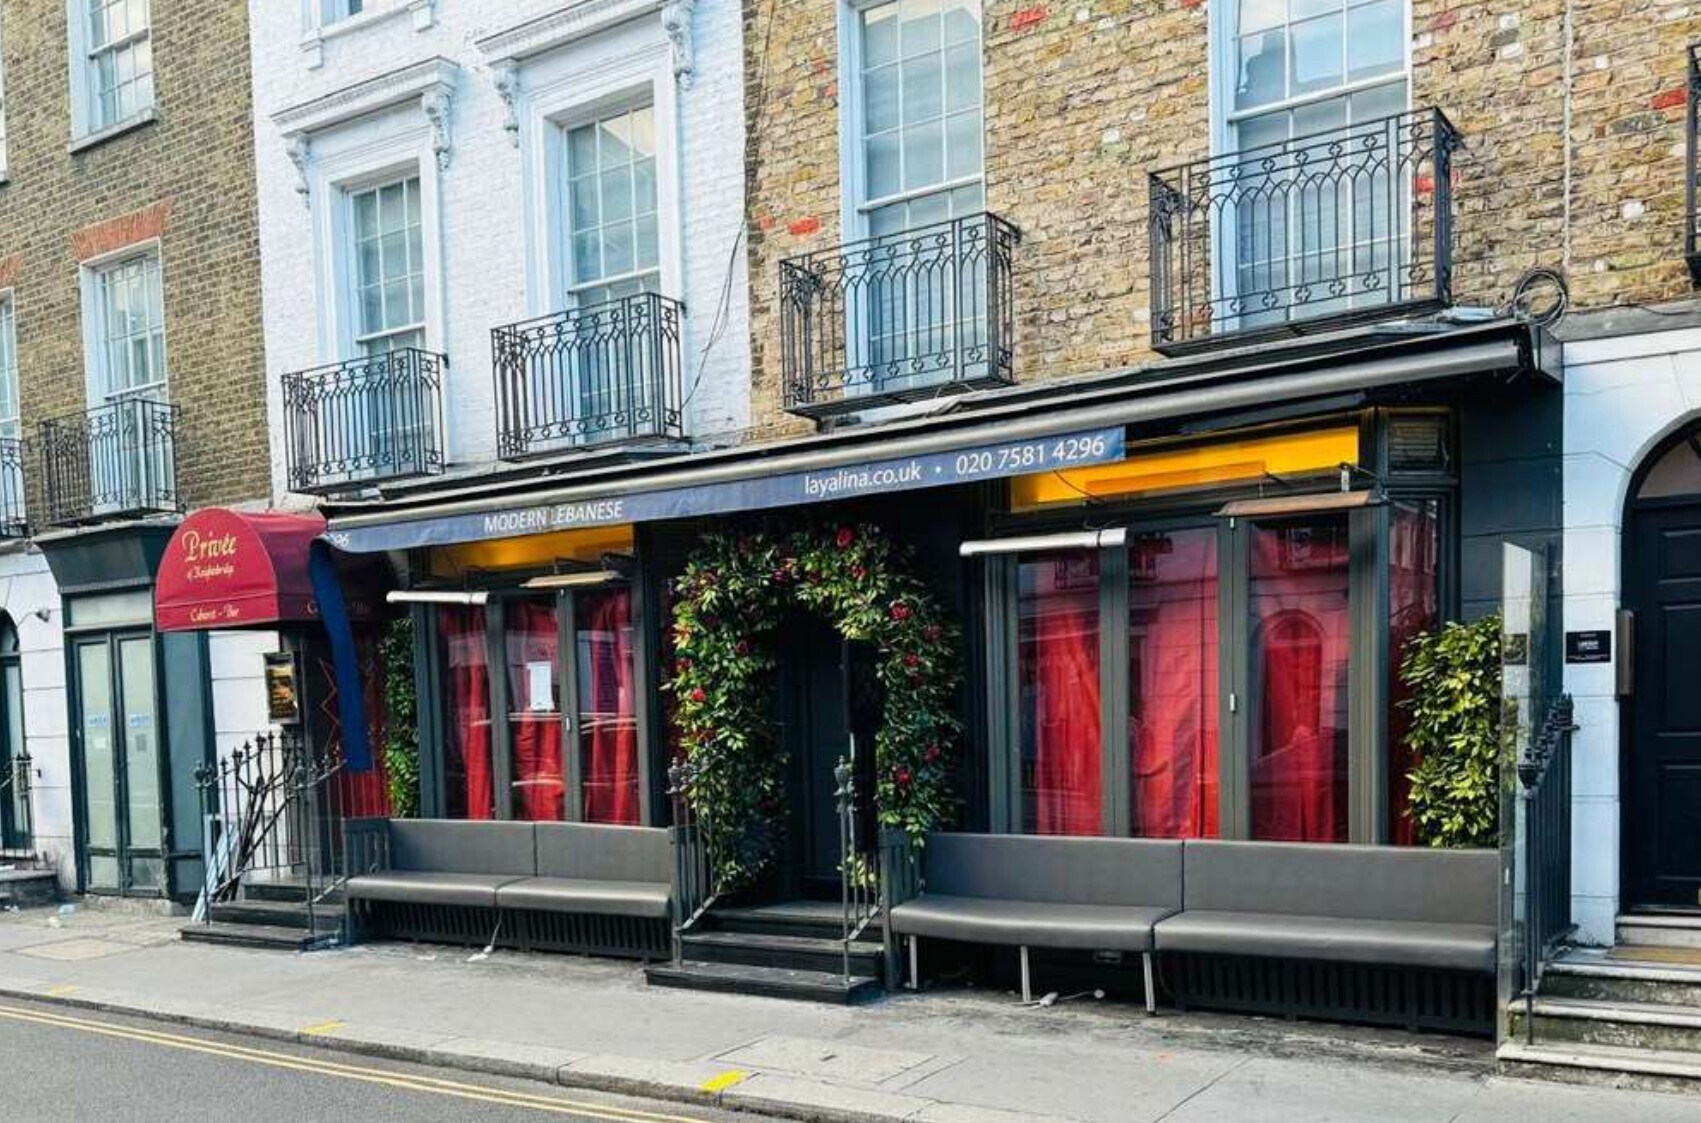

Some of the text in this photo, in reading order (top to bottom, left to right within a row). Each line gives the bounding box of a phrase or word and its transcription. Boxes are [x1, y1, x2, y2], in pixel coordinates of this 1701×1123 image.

[804, 435, 1106, 498] layalina.co.uk 020 7581 4296
[483, 500, 624, 534] MODERN LEBANESE
